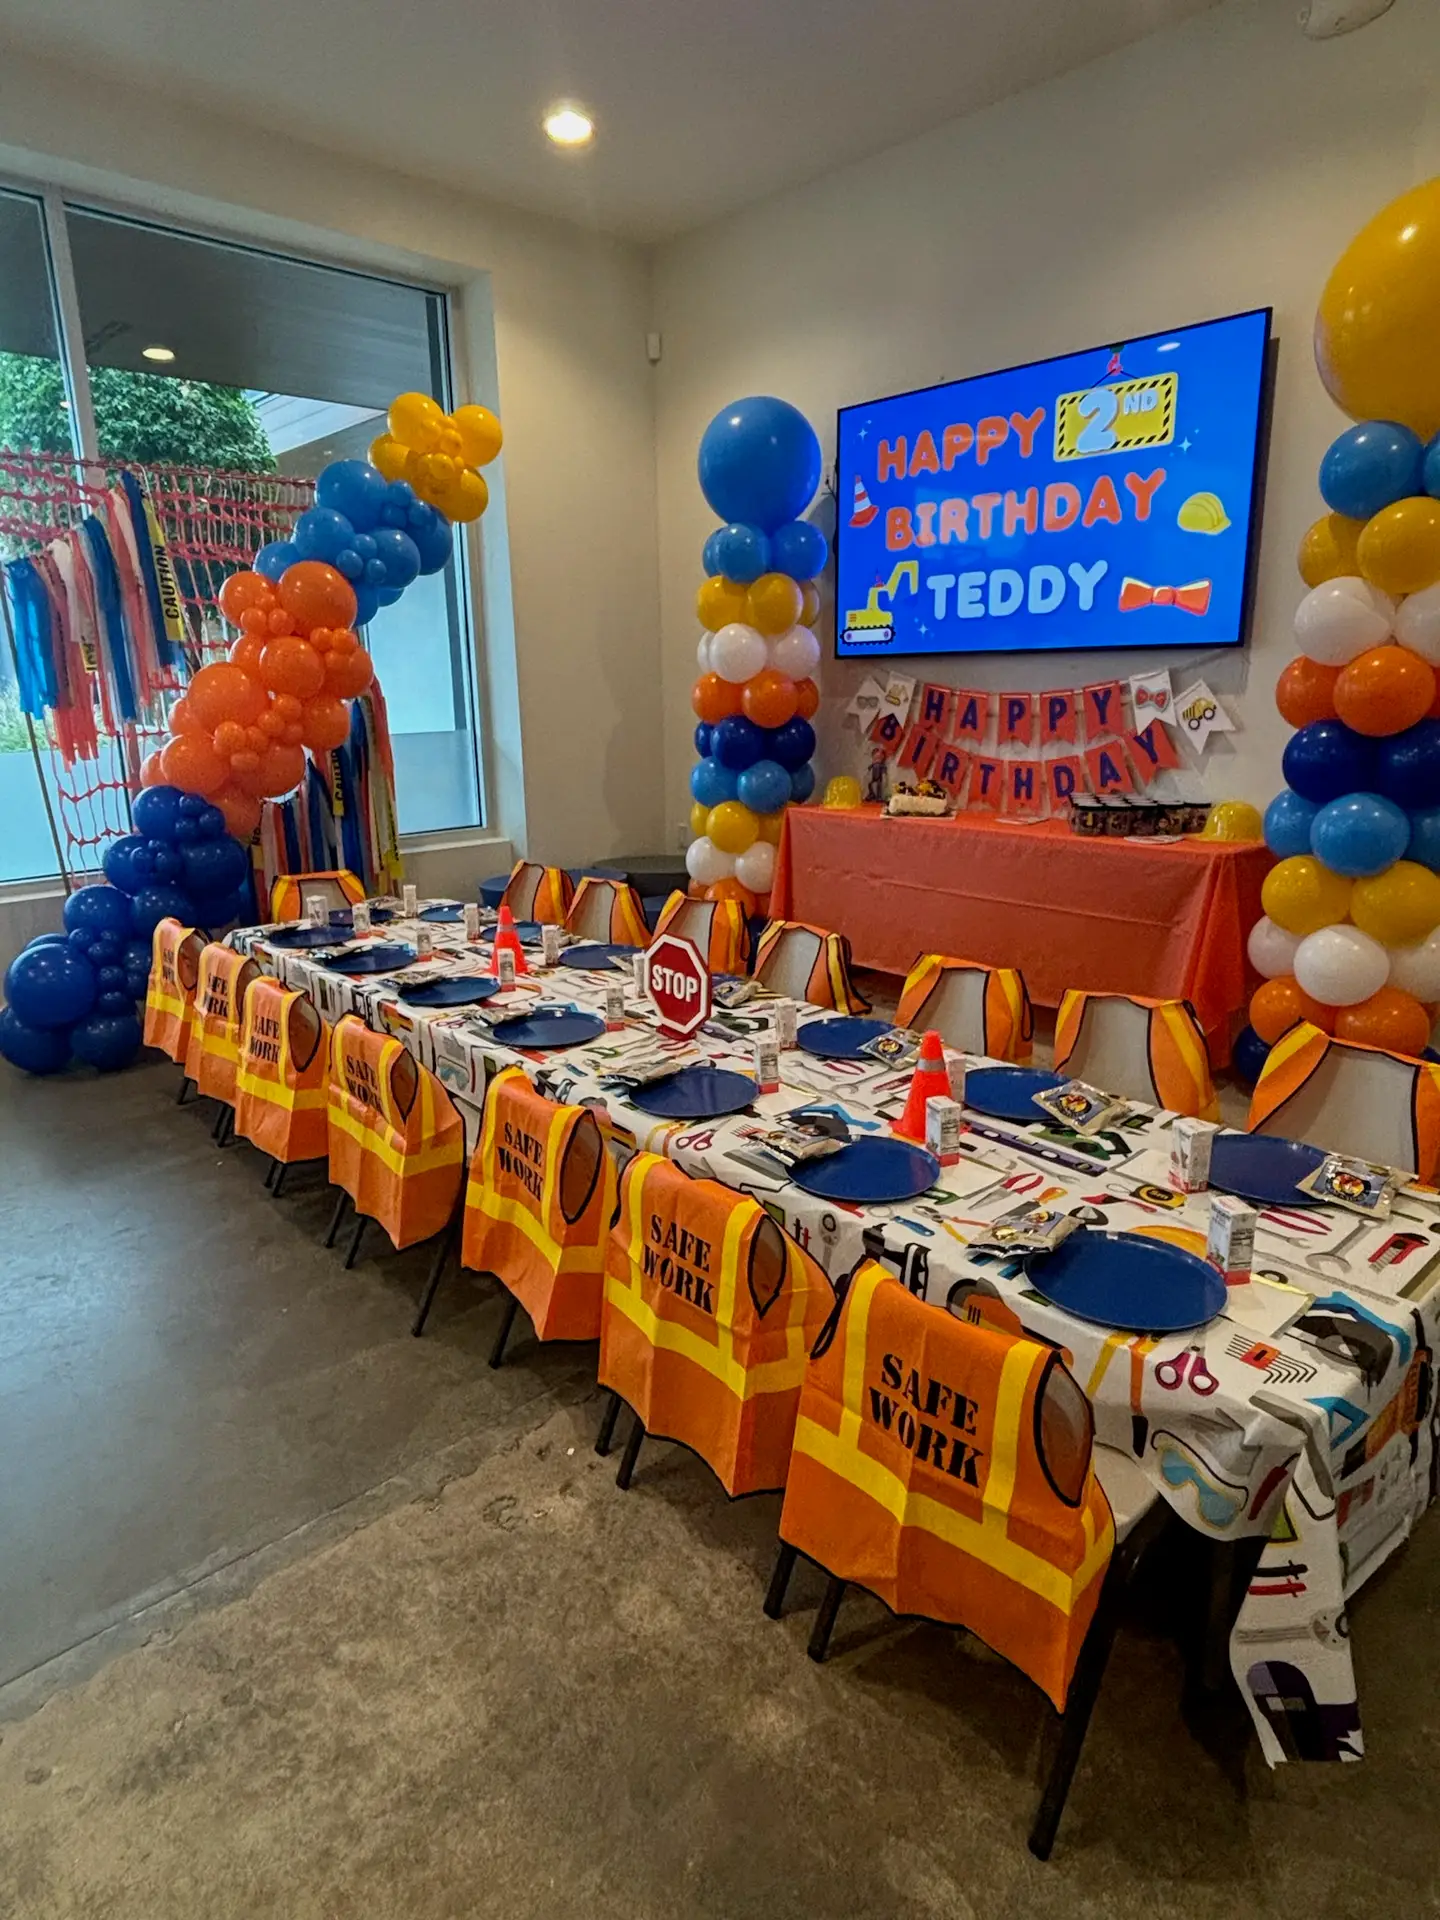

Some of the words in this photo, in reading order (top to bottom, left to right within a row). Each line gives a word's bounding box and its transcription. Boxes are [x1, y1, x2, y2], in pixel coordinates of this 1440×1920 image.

[878, 407, 1046, 482] HAPPY
[886, 468, 1166, 551] BIRTHDAY
[154, 545, 180, 620] CAUTION
[926, 560, 1109, 620] TEDDY
[924, 688, 1113, 733] HAPPY
[880, 713, 1158, 800] BIRTHDAY
[652, 964, 698, 1002] STOP
[497, 1147, 544, 1202] WORK
[503, 1121, 543, 1164] SAFE
[650, 1213, 711, 1273] SAFE
[642, 1246, 716, 1315] WORK
[880, 1352, 979, 1436] SAFE
[868, 1385, 984, 1489] WORK
